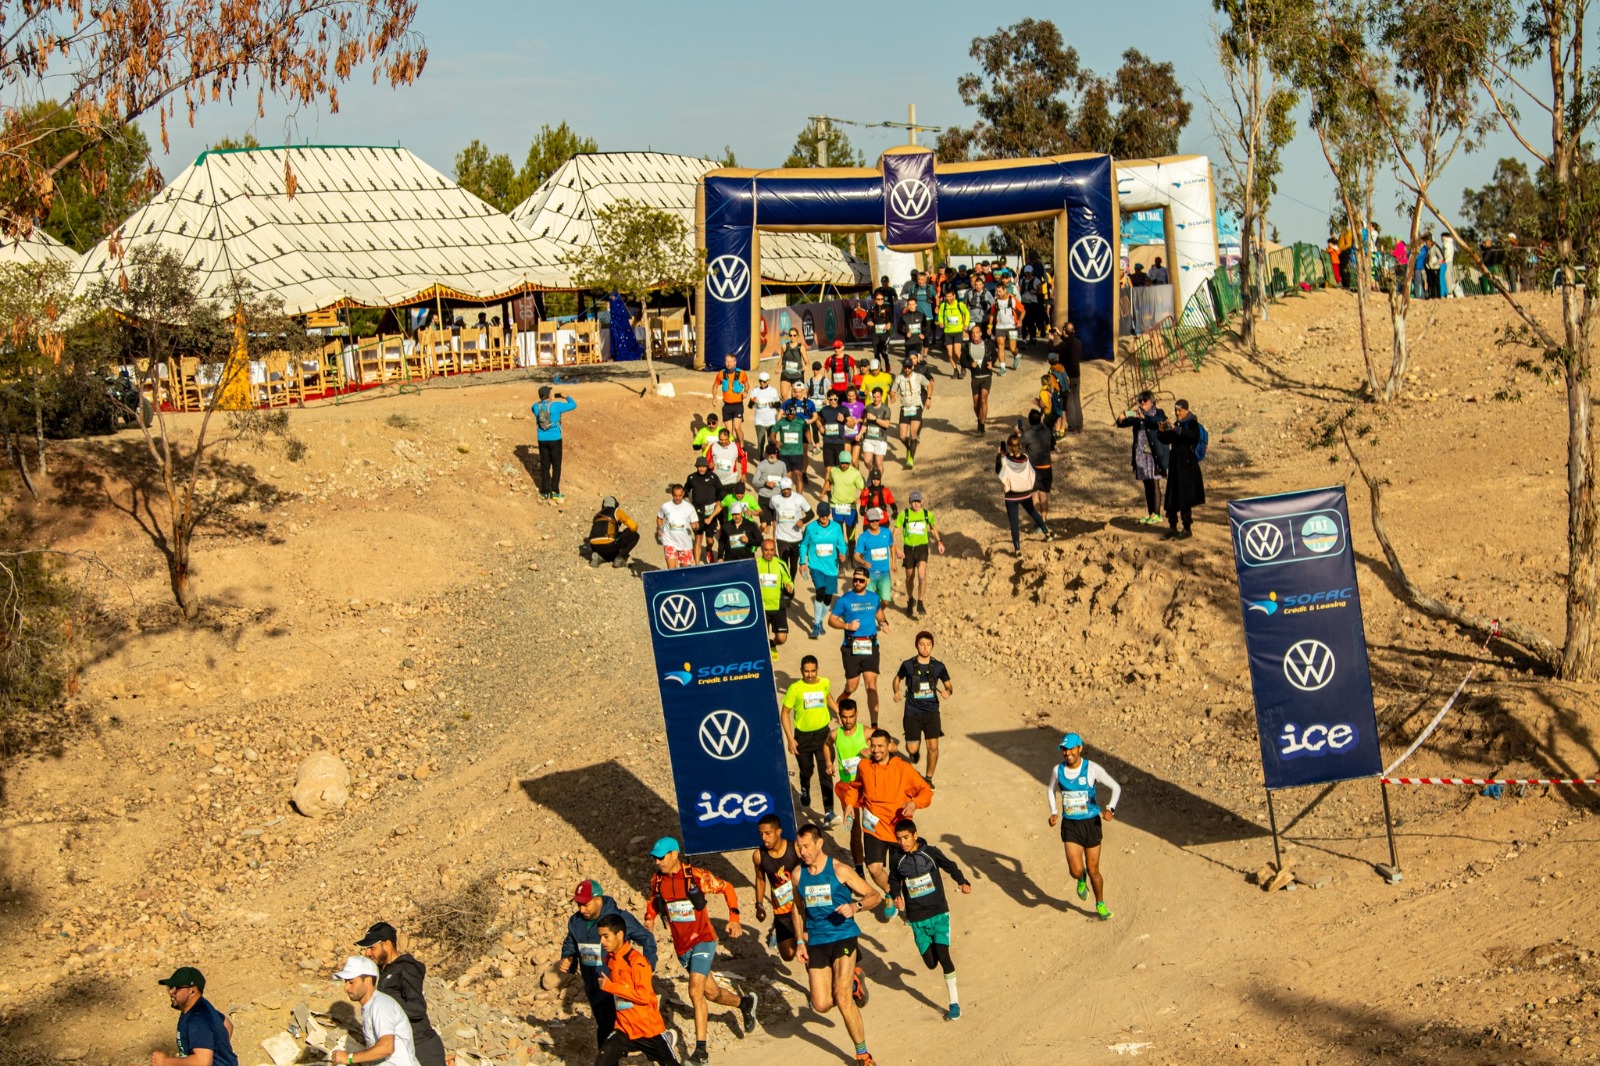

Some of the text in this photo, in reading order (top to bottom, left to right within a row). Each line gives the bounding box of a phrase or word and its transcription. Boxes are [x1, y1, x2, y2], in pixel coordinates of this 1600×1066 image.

[1070, 236, 1112, 281] VW
[707, 255, 749, 300] VW
[1246, 523, 1283, 559] VW
[661, 595, 696, 630] VW
[722, 592, 740, 604] TBT
[1283, 587, 1353, 607] SOFAC
[1316, 601, 1347, 610] Leasing
[697, 659, 766, 678] SOFAC
[729, 672, 760, 681] Leasing
[1284, 639, 1336, 691] VW
[699, 709, 750, 760] VW
[1280, 723, 1353, 755] ice
[697, 791, 769, 822] ice
